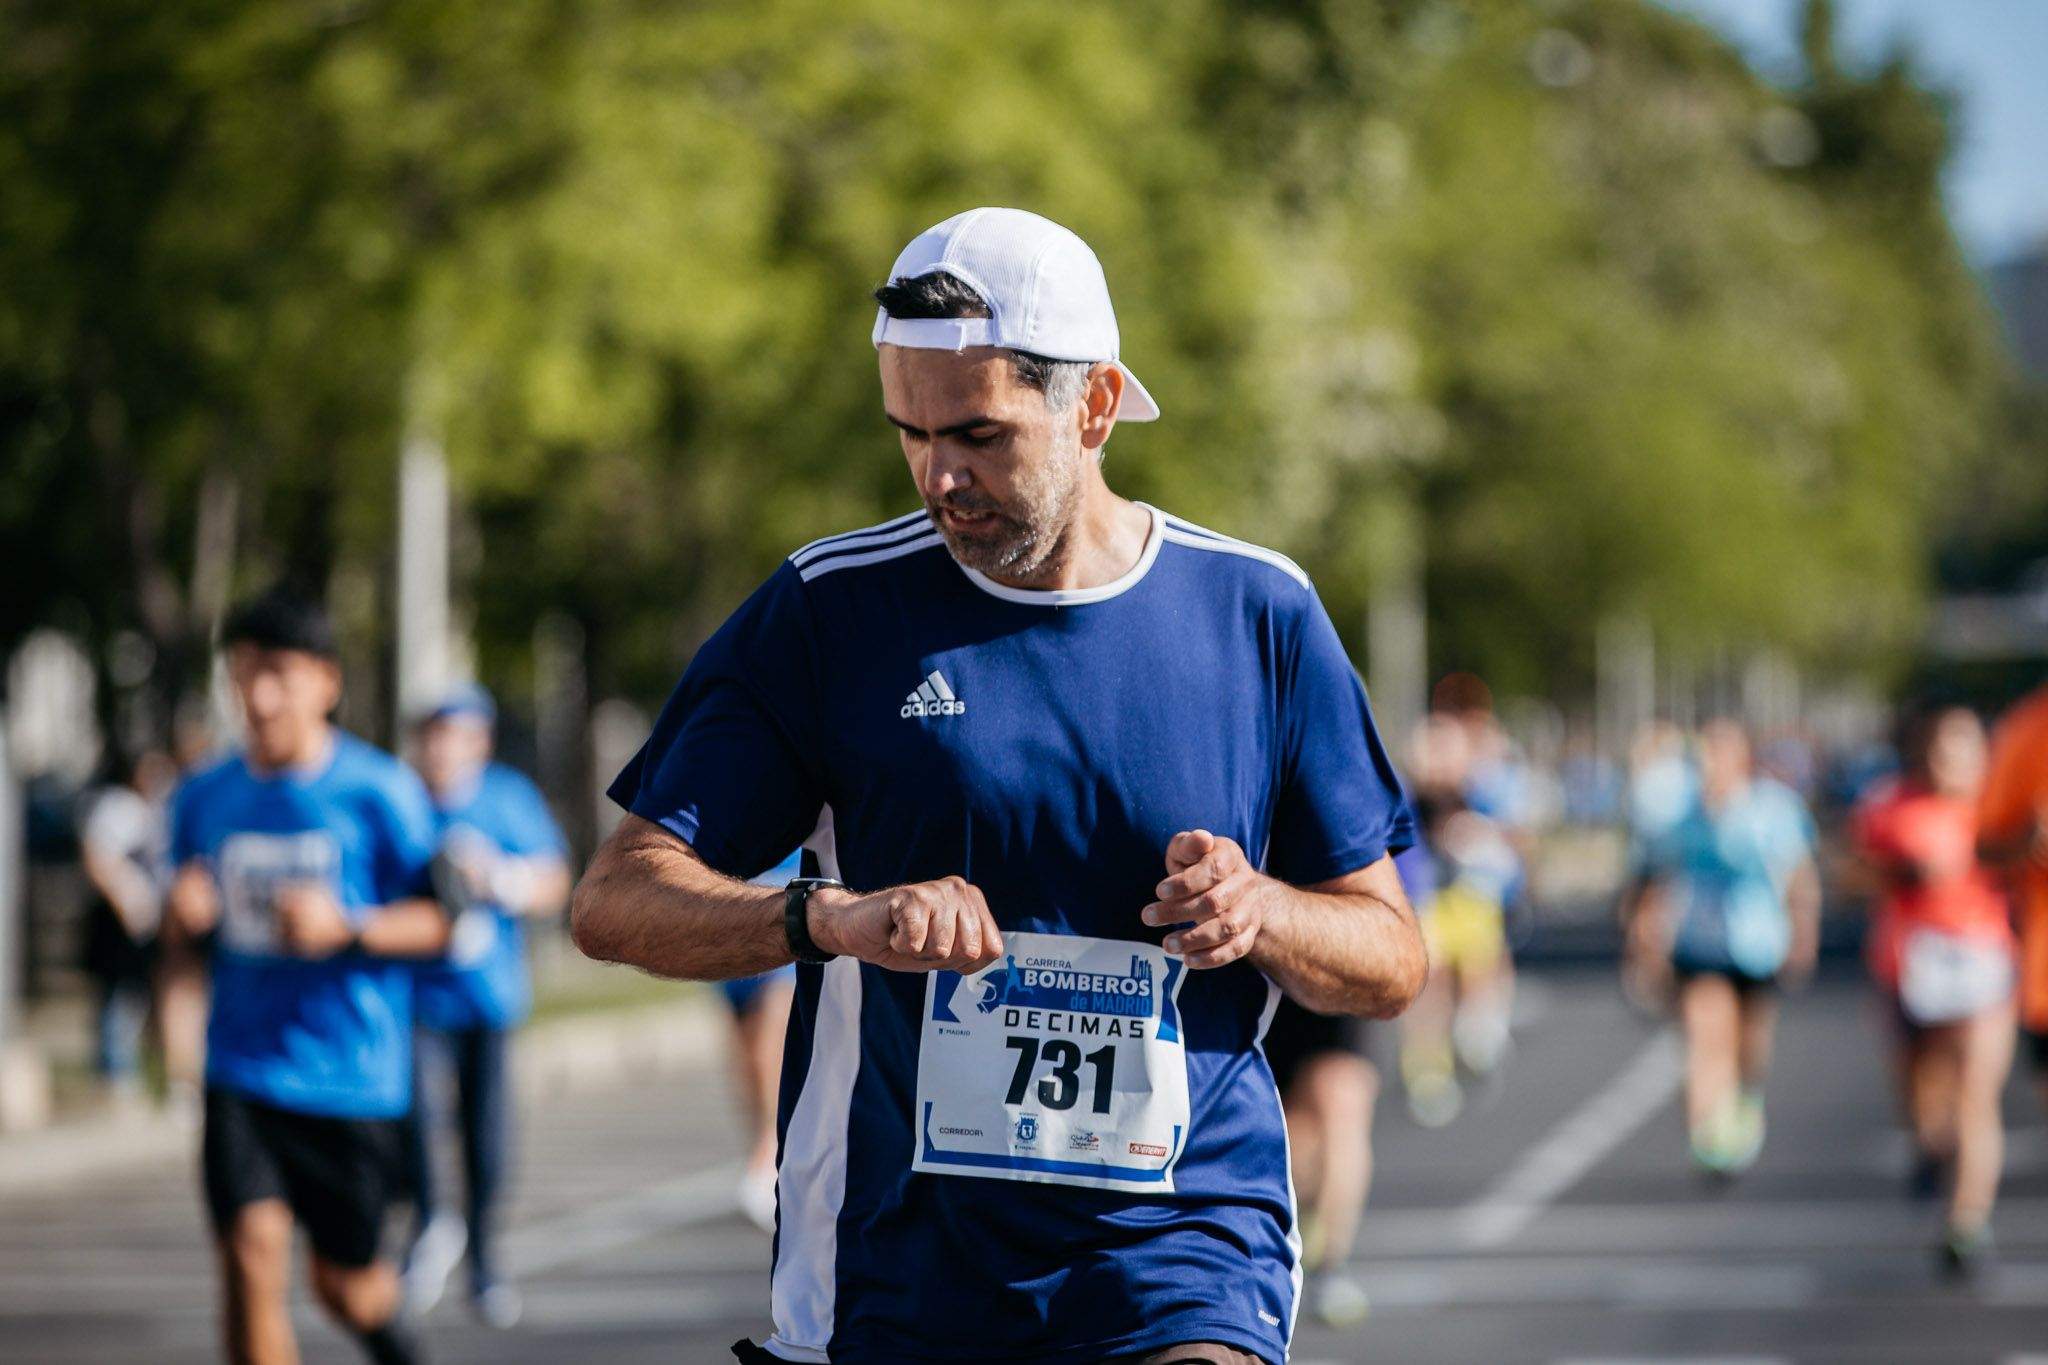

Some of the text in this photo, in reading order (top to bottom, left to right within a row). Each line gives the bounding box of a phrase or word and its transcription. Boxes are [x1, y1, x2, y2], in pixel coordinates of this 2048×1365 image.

[900, 698, 966, 719] adidas
[1025, 957, 1072, 969] CARRERA
[1024, 969, 1151, 997] BOMBEROS
[1070, 992, 1151, 1016] de MADRID
[1004, 1008, 1144, 1039] DECIMAS
[1005, 1036, 1116, 1115] 731
